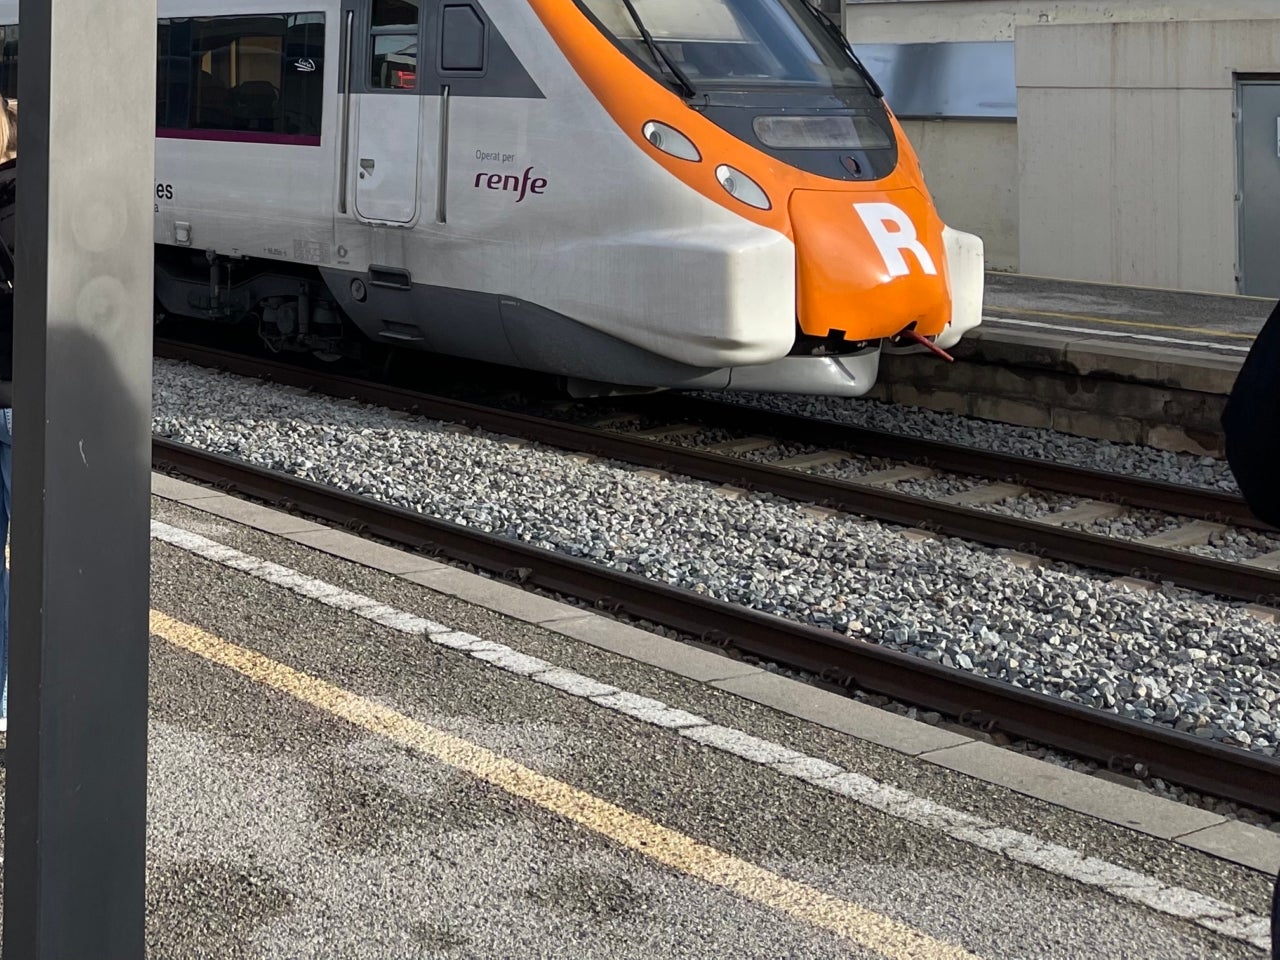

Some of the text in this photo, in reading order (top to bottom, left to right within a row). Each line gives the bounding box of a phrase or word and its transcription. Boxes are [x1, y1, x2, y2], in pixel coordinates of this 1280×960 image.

[475, 149, 515, 164] Operat per
[474, 166, 548, 203] renfe
[853, 202, 937, 277] R
